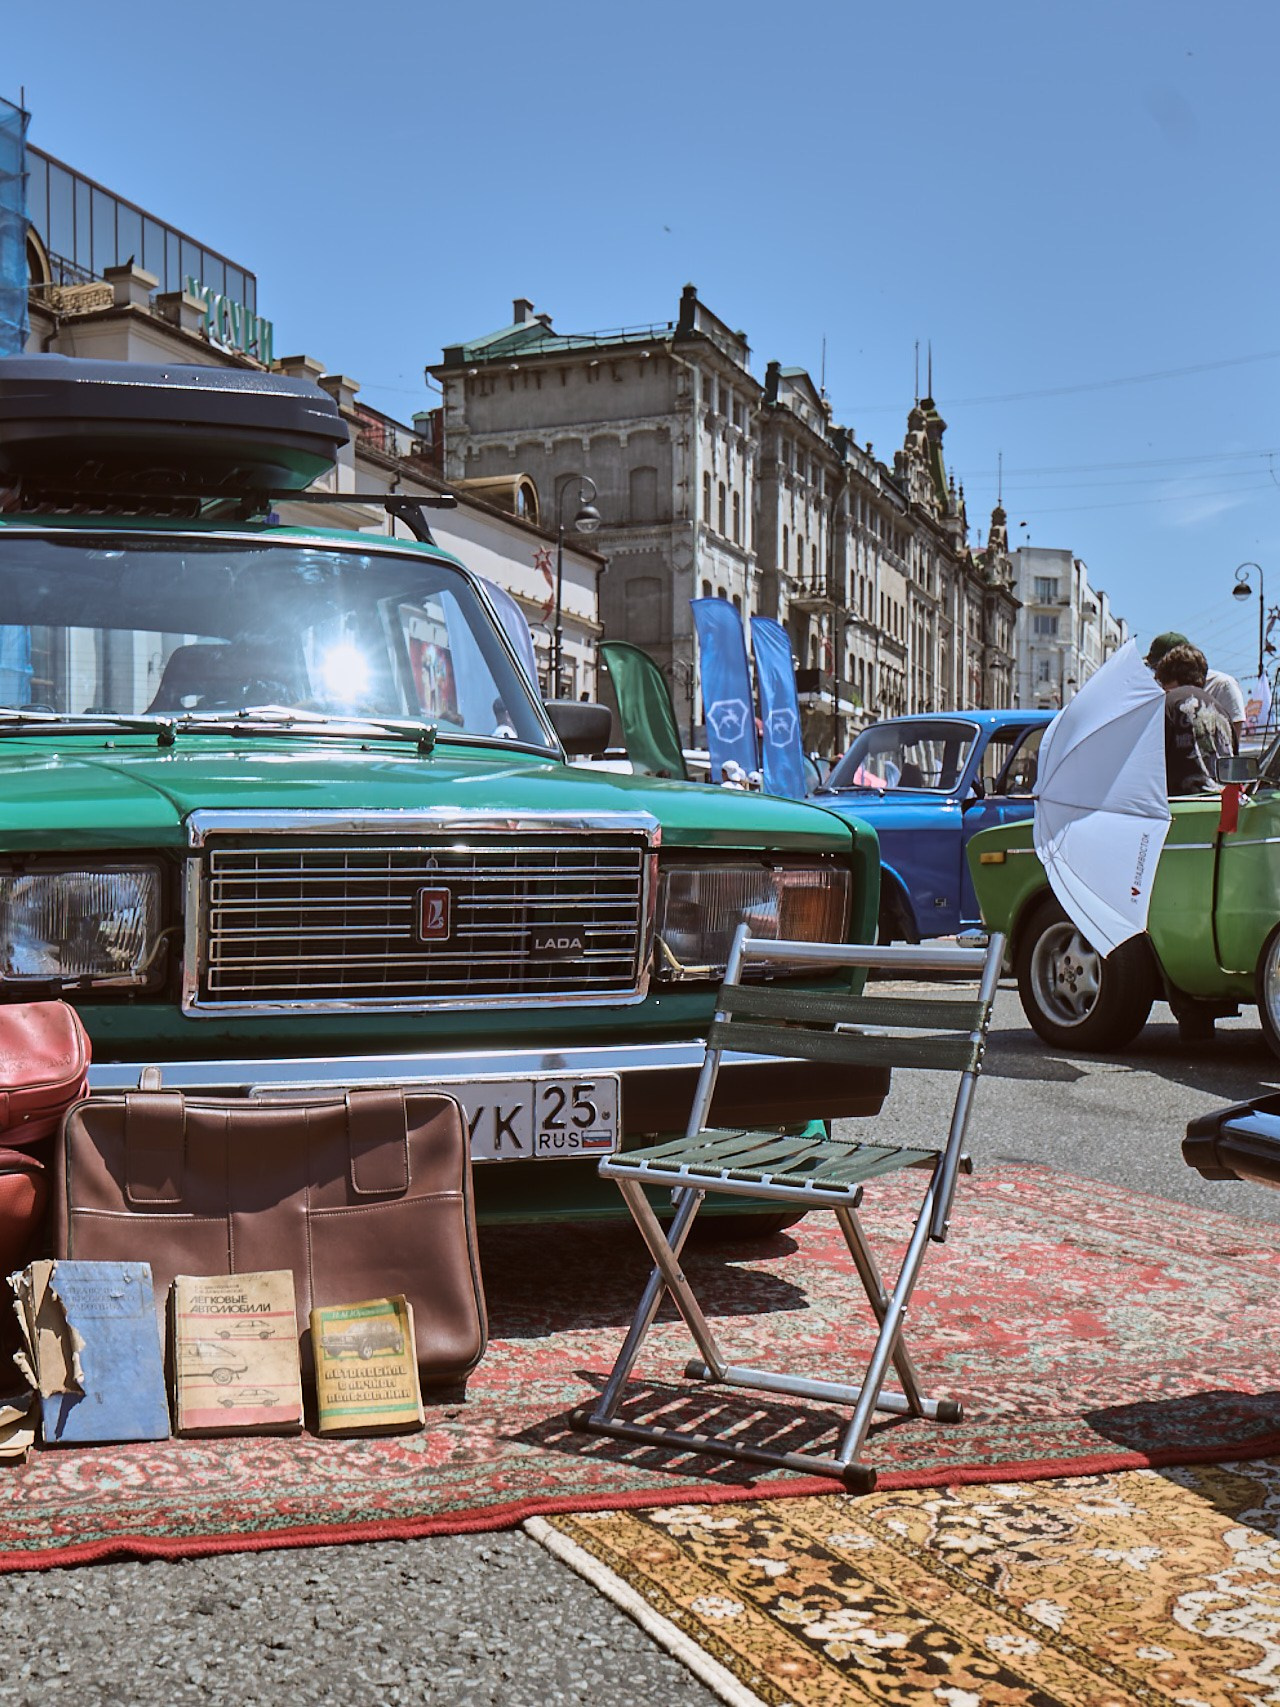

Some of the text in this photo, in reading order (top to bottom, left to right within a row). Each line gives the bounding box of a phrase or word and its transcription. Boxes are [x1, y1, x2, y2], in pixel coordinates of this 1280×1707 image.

[1133, 832, 1150, 887] ВЛАДИВОСТОК
[535, 937, 582, 949] LADA
[542, 1083, 597, 1130] 25
[539, 1131, 580, 1149] RUS
[189, 1294, 248, 1304] ЛЕГКОВЫЕ
[189, 1303, 271, 1313] АВТОМОБИЛИ
[325, 1365, 407, 1380] АВТОМОБИЛЬ
[348, 1379, 397, 1390] ЛИЧНОМ
[327, 1389, 411, 1404] ПОЛЬЗОВАНИИ
